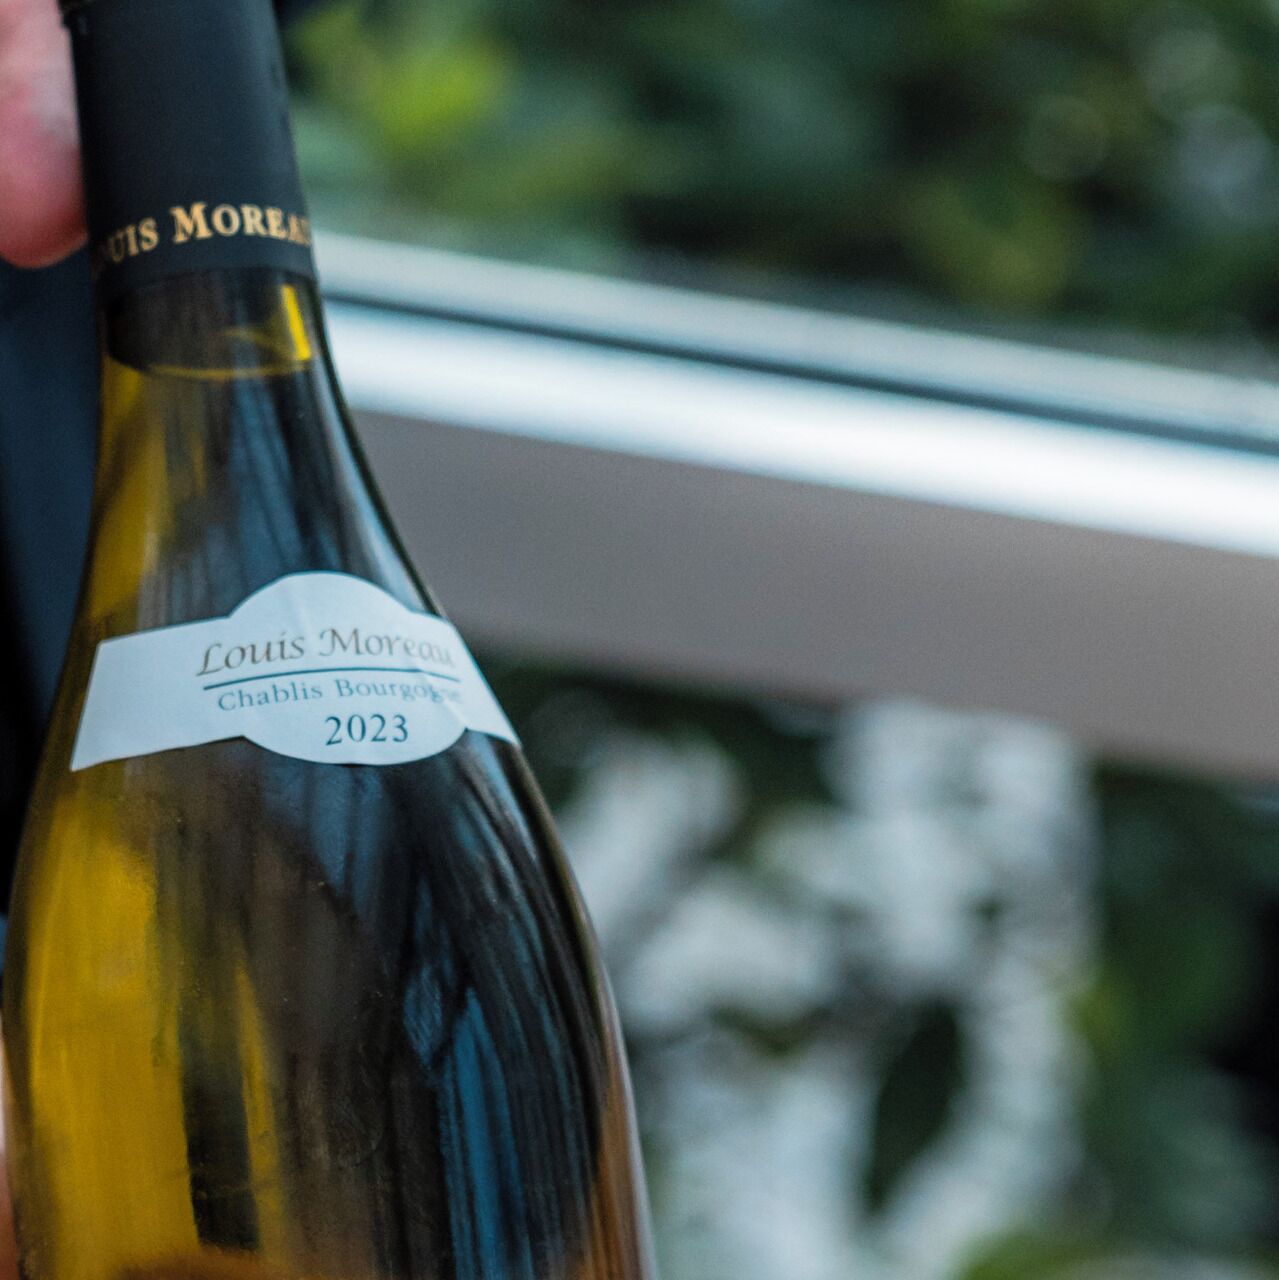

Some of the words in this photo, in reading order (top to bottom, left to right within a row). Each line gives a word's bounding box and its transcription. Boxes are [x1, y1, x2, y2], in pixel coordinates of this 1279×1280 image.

[107, 216, 160, 263] UIS
[170, 202, 312, 247] MOREA
[195, 631, 305, 677] Louis
[319, 627, 456, 668] Moreau
[218, 680, 323, 711] Chablis
[325, 713, 408, 746] 2023
